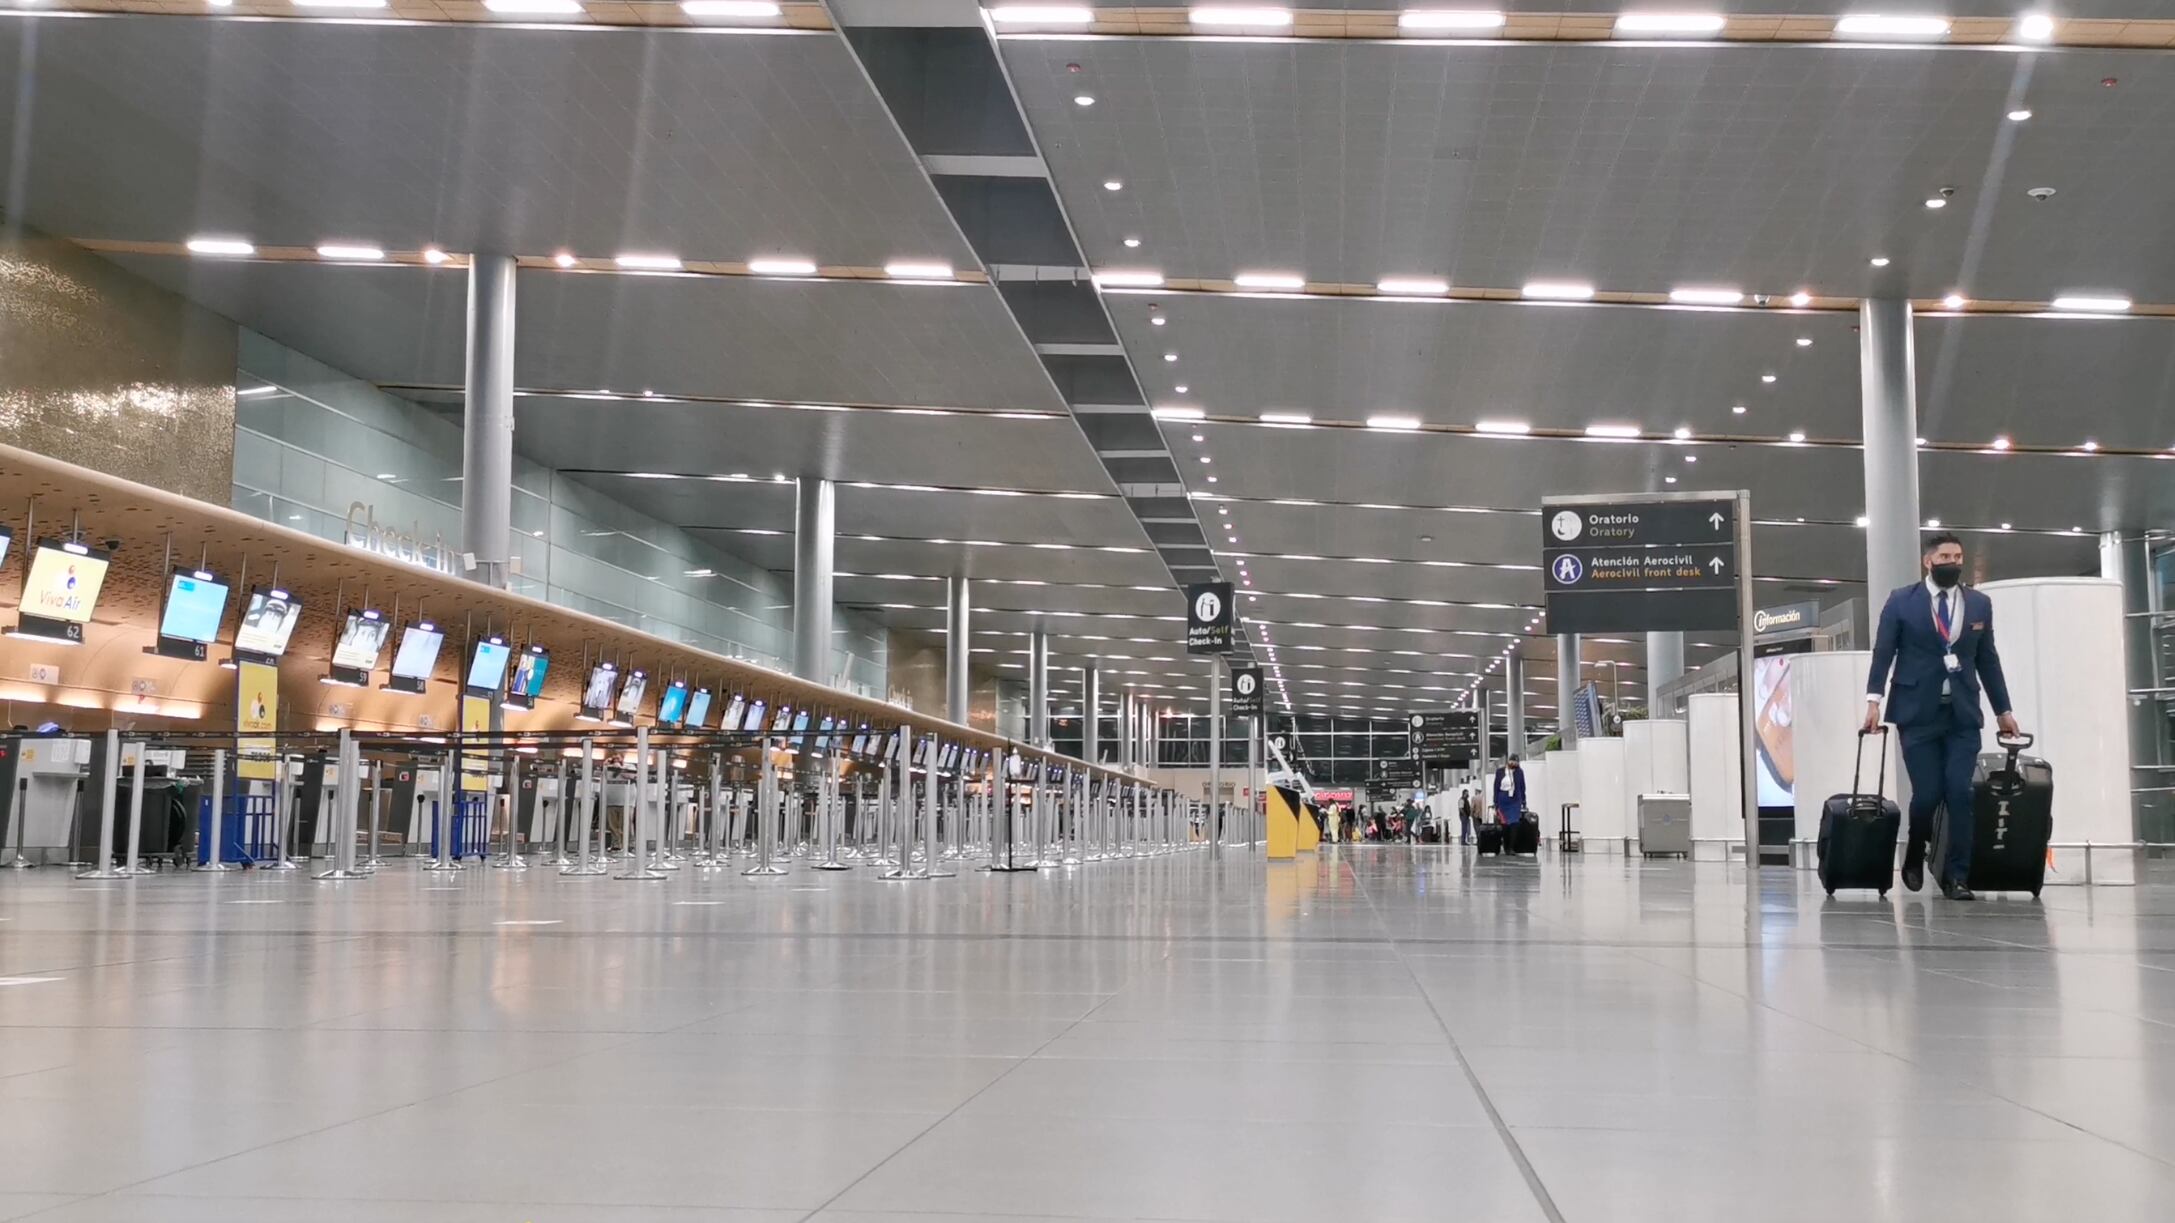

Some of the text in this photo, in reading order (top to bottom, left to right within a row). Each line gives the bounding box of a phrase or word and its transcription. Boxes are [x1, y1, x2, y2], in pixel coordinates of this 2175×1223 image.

[1589, 514, 1640, 526] Oratorio
[1589, 526, 1635, 539] Oratory
[1591, 555, 1693, 567] Atención Aerocivil
[1591, 566, 1702, 579] Aerocivil front desk
[66, 626, 80, 639] 62
[194, 644, 206, 658] 61
